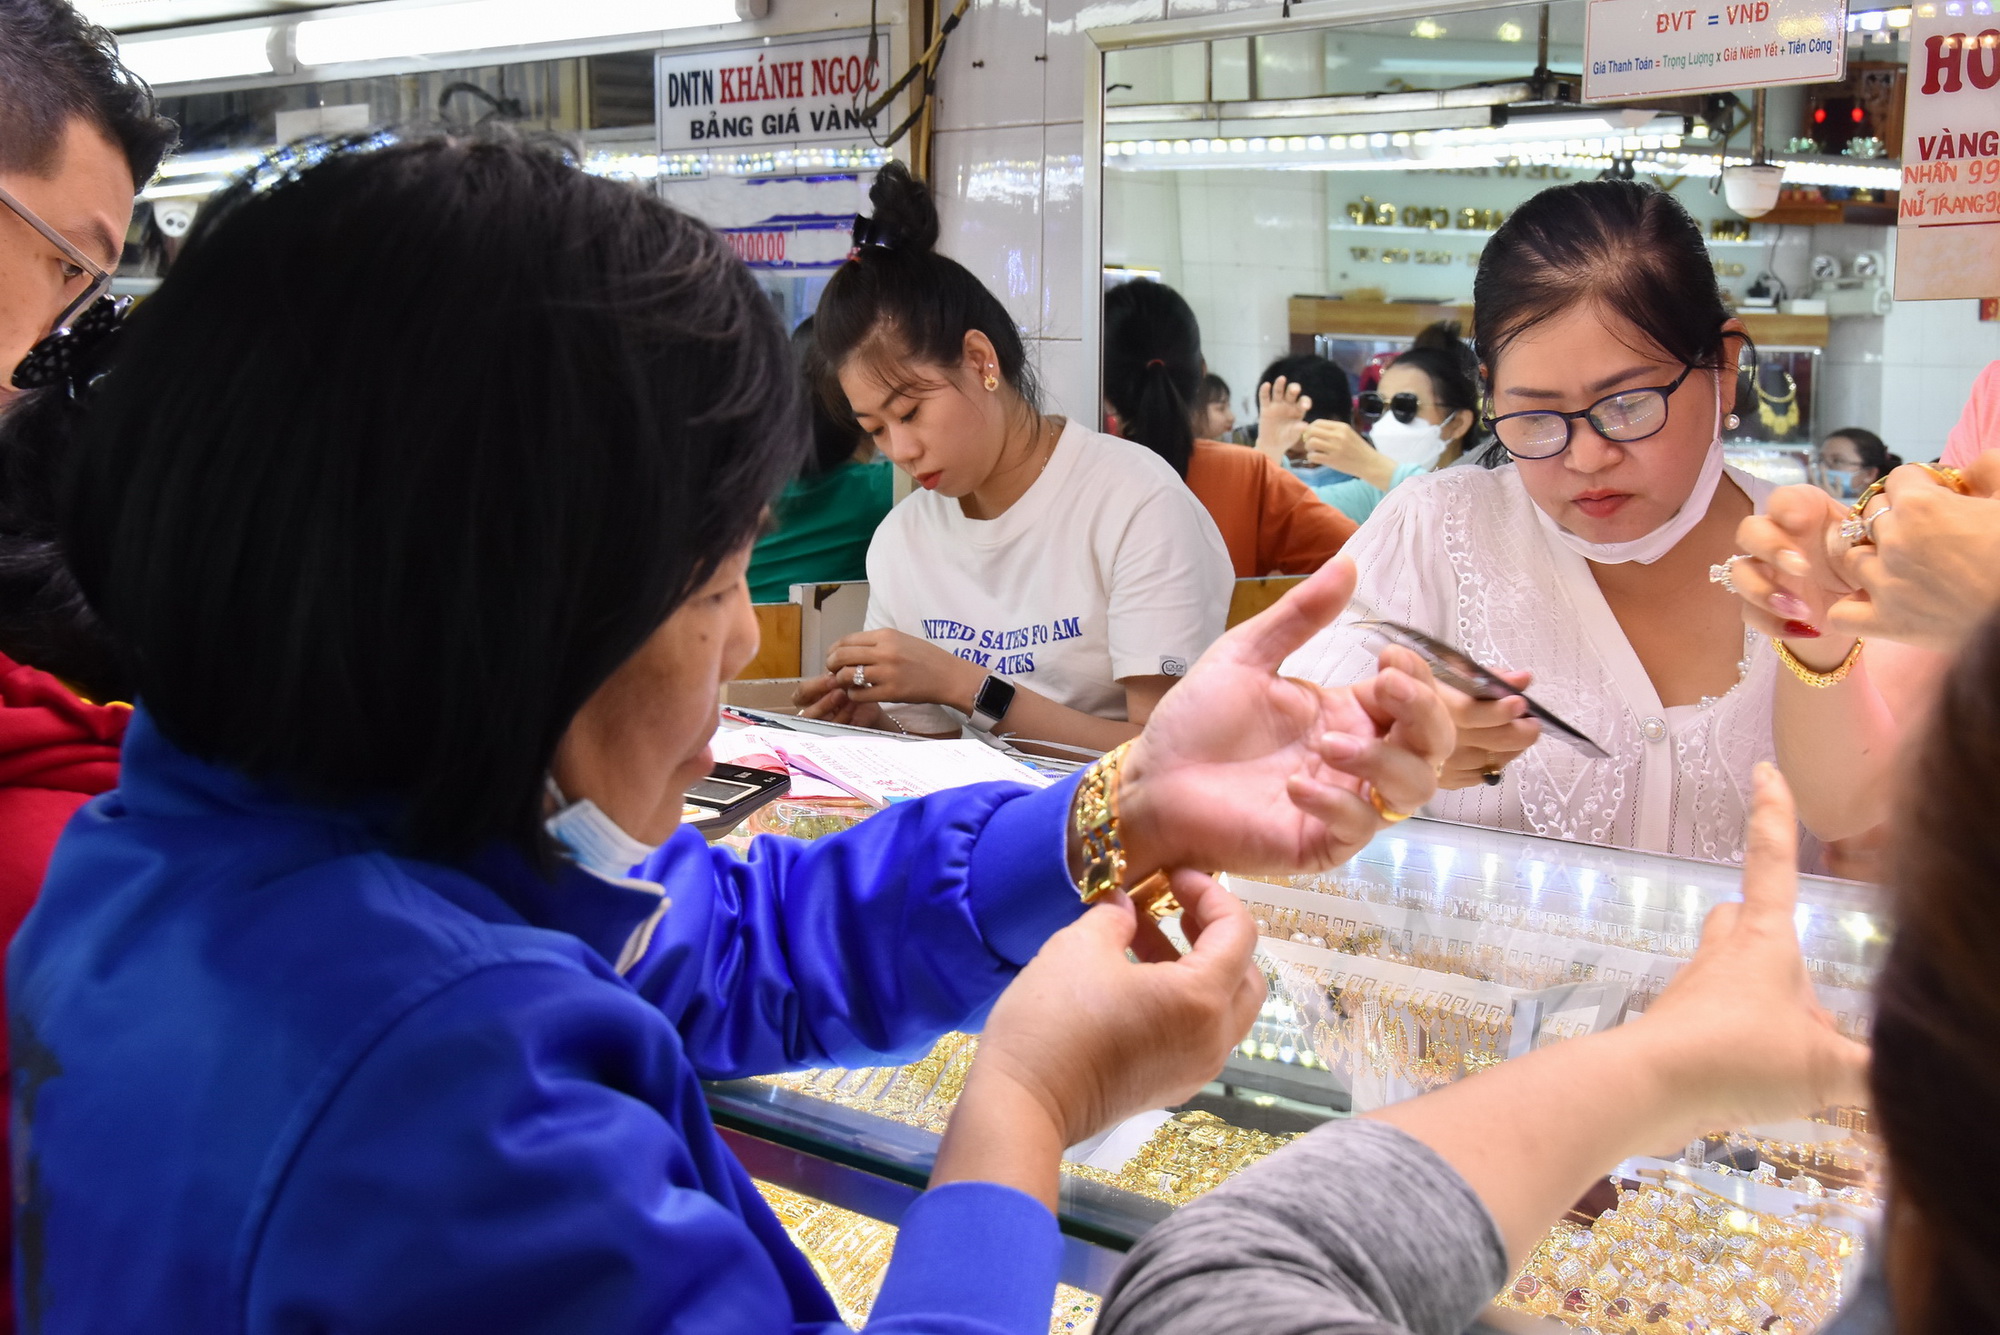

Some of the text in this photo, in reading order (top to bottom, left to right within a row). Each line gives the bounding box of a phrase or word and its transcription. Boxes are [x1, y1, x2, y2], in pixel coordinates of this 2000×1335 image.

[1656, 10, 1696, 34] ĐVT
[1726, 1, 1770, 25] VNĐ
[1593, 61, 1606, 75] Giá
[1608, 59, 1633, 73] Thanh
[1634, 56, 1653, 70] Toán
[1662, 54, 1686, 70] Trọng
[1688, 52, 1714, 67] Lượng
[1723, 46, 1738, 62] Giá
[1739, 45, 1761, 60] Niêm
[1764, 41, 1778, 57] Yết
[1809, 38, 1832, 54] Công
[669, 69, 713, 108] DNTN
[719, 54, 804, 104] KHÁNH
[690, 110, 753, 140] BẢNG
[761, 106, 800, 135] GIÁ
[1918, 128, 1999, 161] VÀNG
[1052, 616, 1083, 641] AM
[995, 652, 1035, 675] ATES
